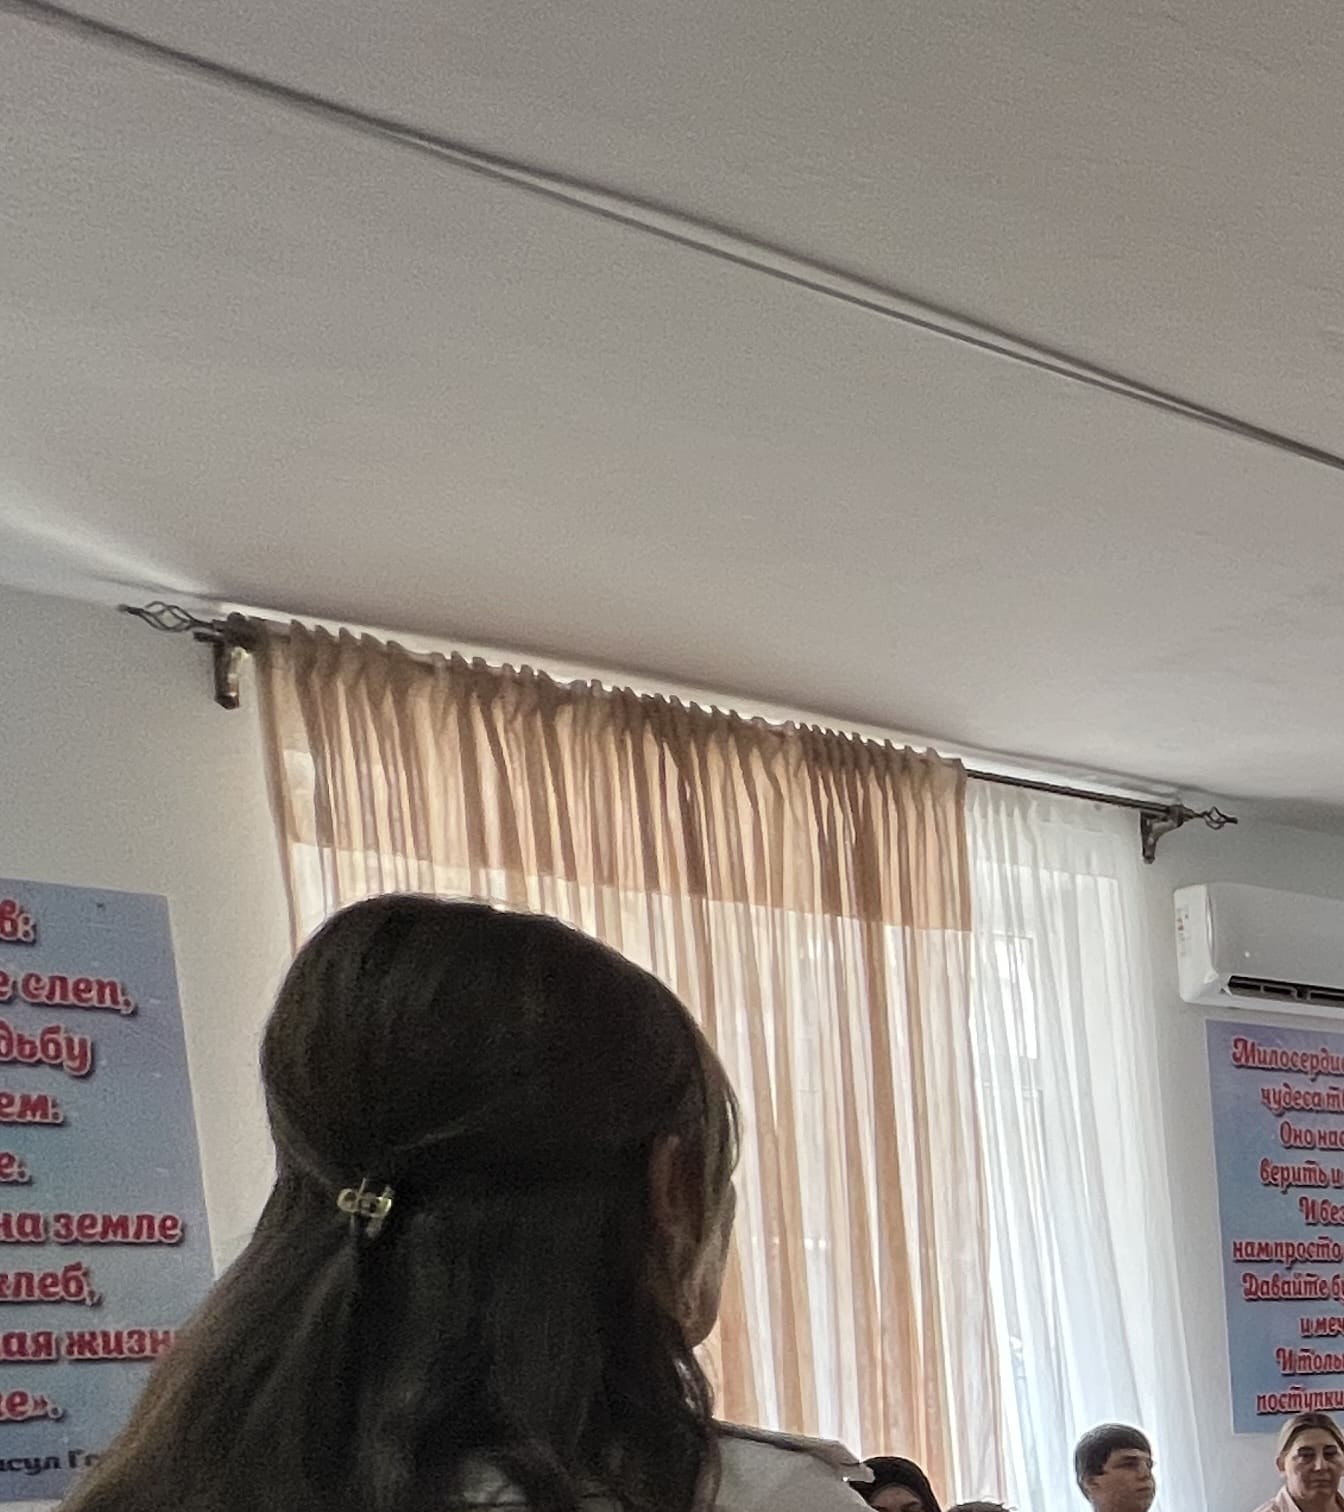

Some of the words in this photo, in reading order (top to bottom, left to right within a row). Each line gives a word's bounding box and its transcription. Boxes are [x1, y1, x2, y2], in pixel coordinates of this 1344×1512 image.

[20, 971, 134, 1014] слеп,
[1261, 1083, 1325, 1113] чудеса
[1280, 1120, 1315, 1148] Оно
[1260, 1157, 1328, 1192] верить
[1330, 1168, 1343, 1188] и
[1299, 1196, 1318, 1224] И
[51, 1211, 184, 1244] земле
[1233, 1240, 1274, 1261] нам
[1274, 1236, 1343, 1268] просто
[1242, 1272, 1329, 1299] Давайте
[1300, 1315, 1313, 1336] и
[65, 1328, 175, 1359] жизн
[1276, 1347, 1295, 1374] И
[0, 1390, 64, 1420] е».
[1256, 1384, 1344, 1414] поступки
[0, 1455, 61, 1476] сул
